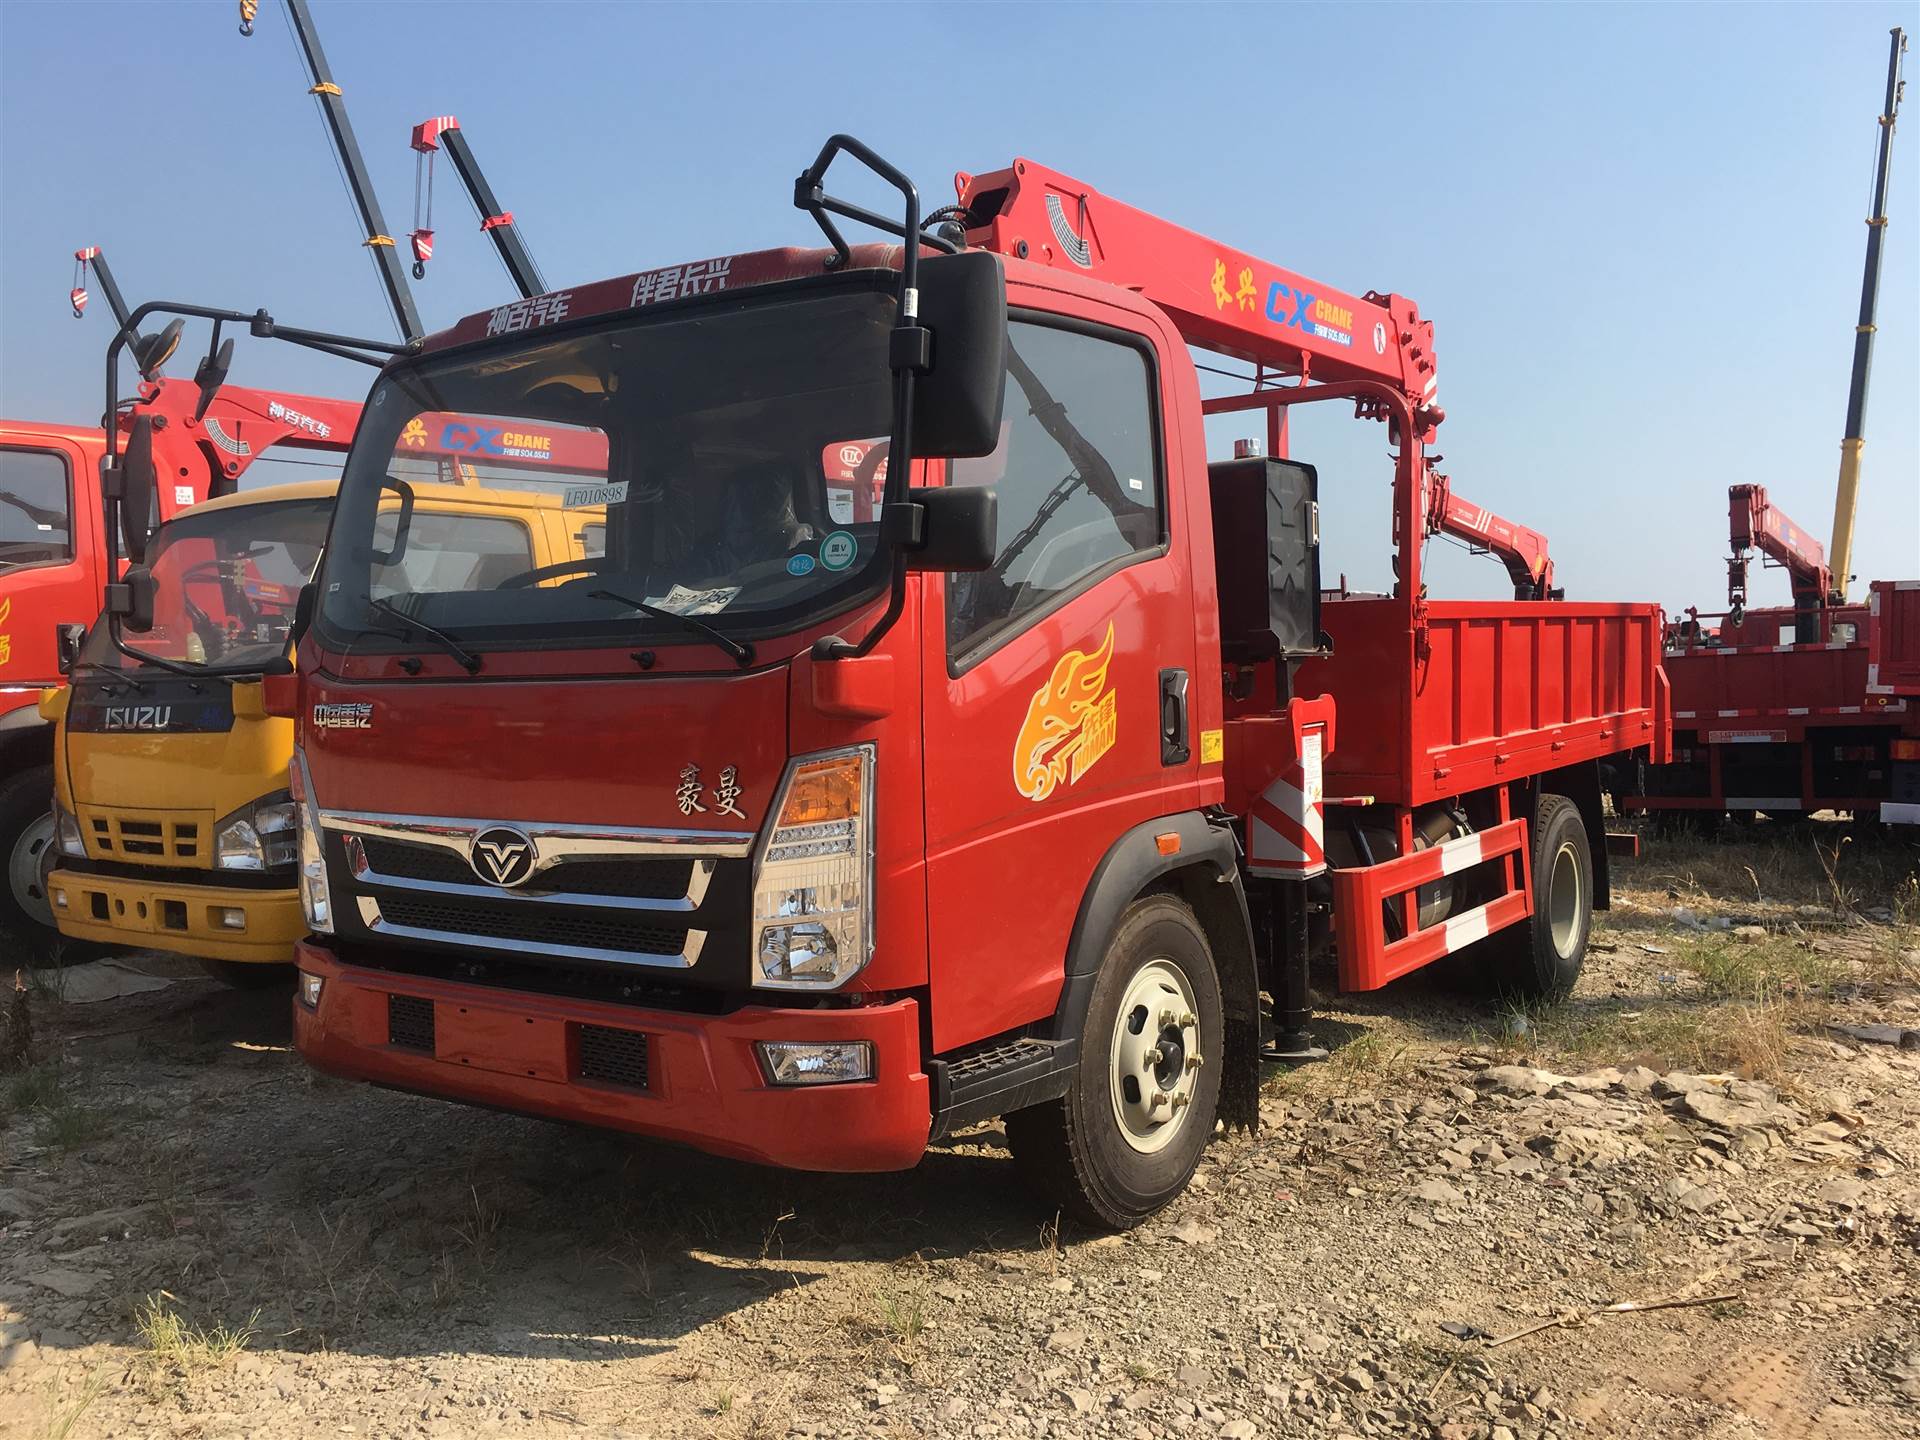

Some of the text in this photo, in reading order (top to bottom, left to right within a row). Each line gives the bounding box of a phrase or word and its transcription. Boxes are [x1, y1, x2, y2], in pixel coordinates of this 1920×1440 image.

[486, 256, 732, 336] 神百汽车 伴君长兴
[1265, 281, 1316, 334] CX
[1316, 299, 1353, 329] CRANE
[268, 400, 332, 438] 神百汽车
[440, 422, 503, 455] CX
[503, 432, 551, 450] CRANE
[566, 486, 623, 506] LF010898
[105, 706, 171, 729] ISUZU
[313, 703, 374, 729] 中国重汽
[675, 762, 746, 820] 豪曼
